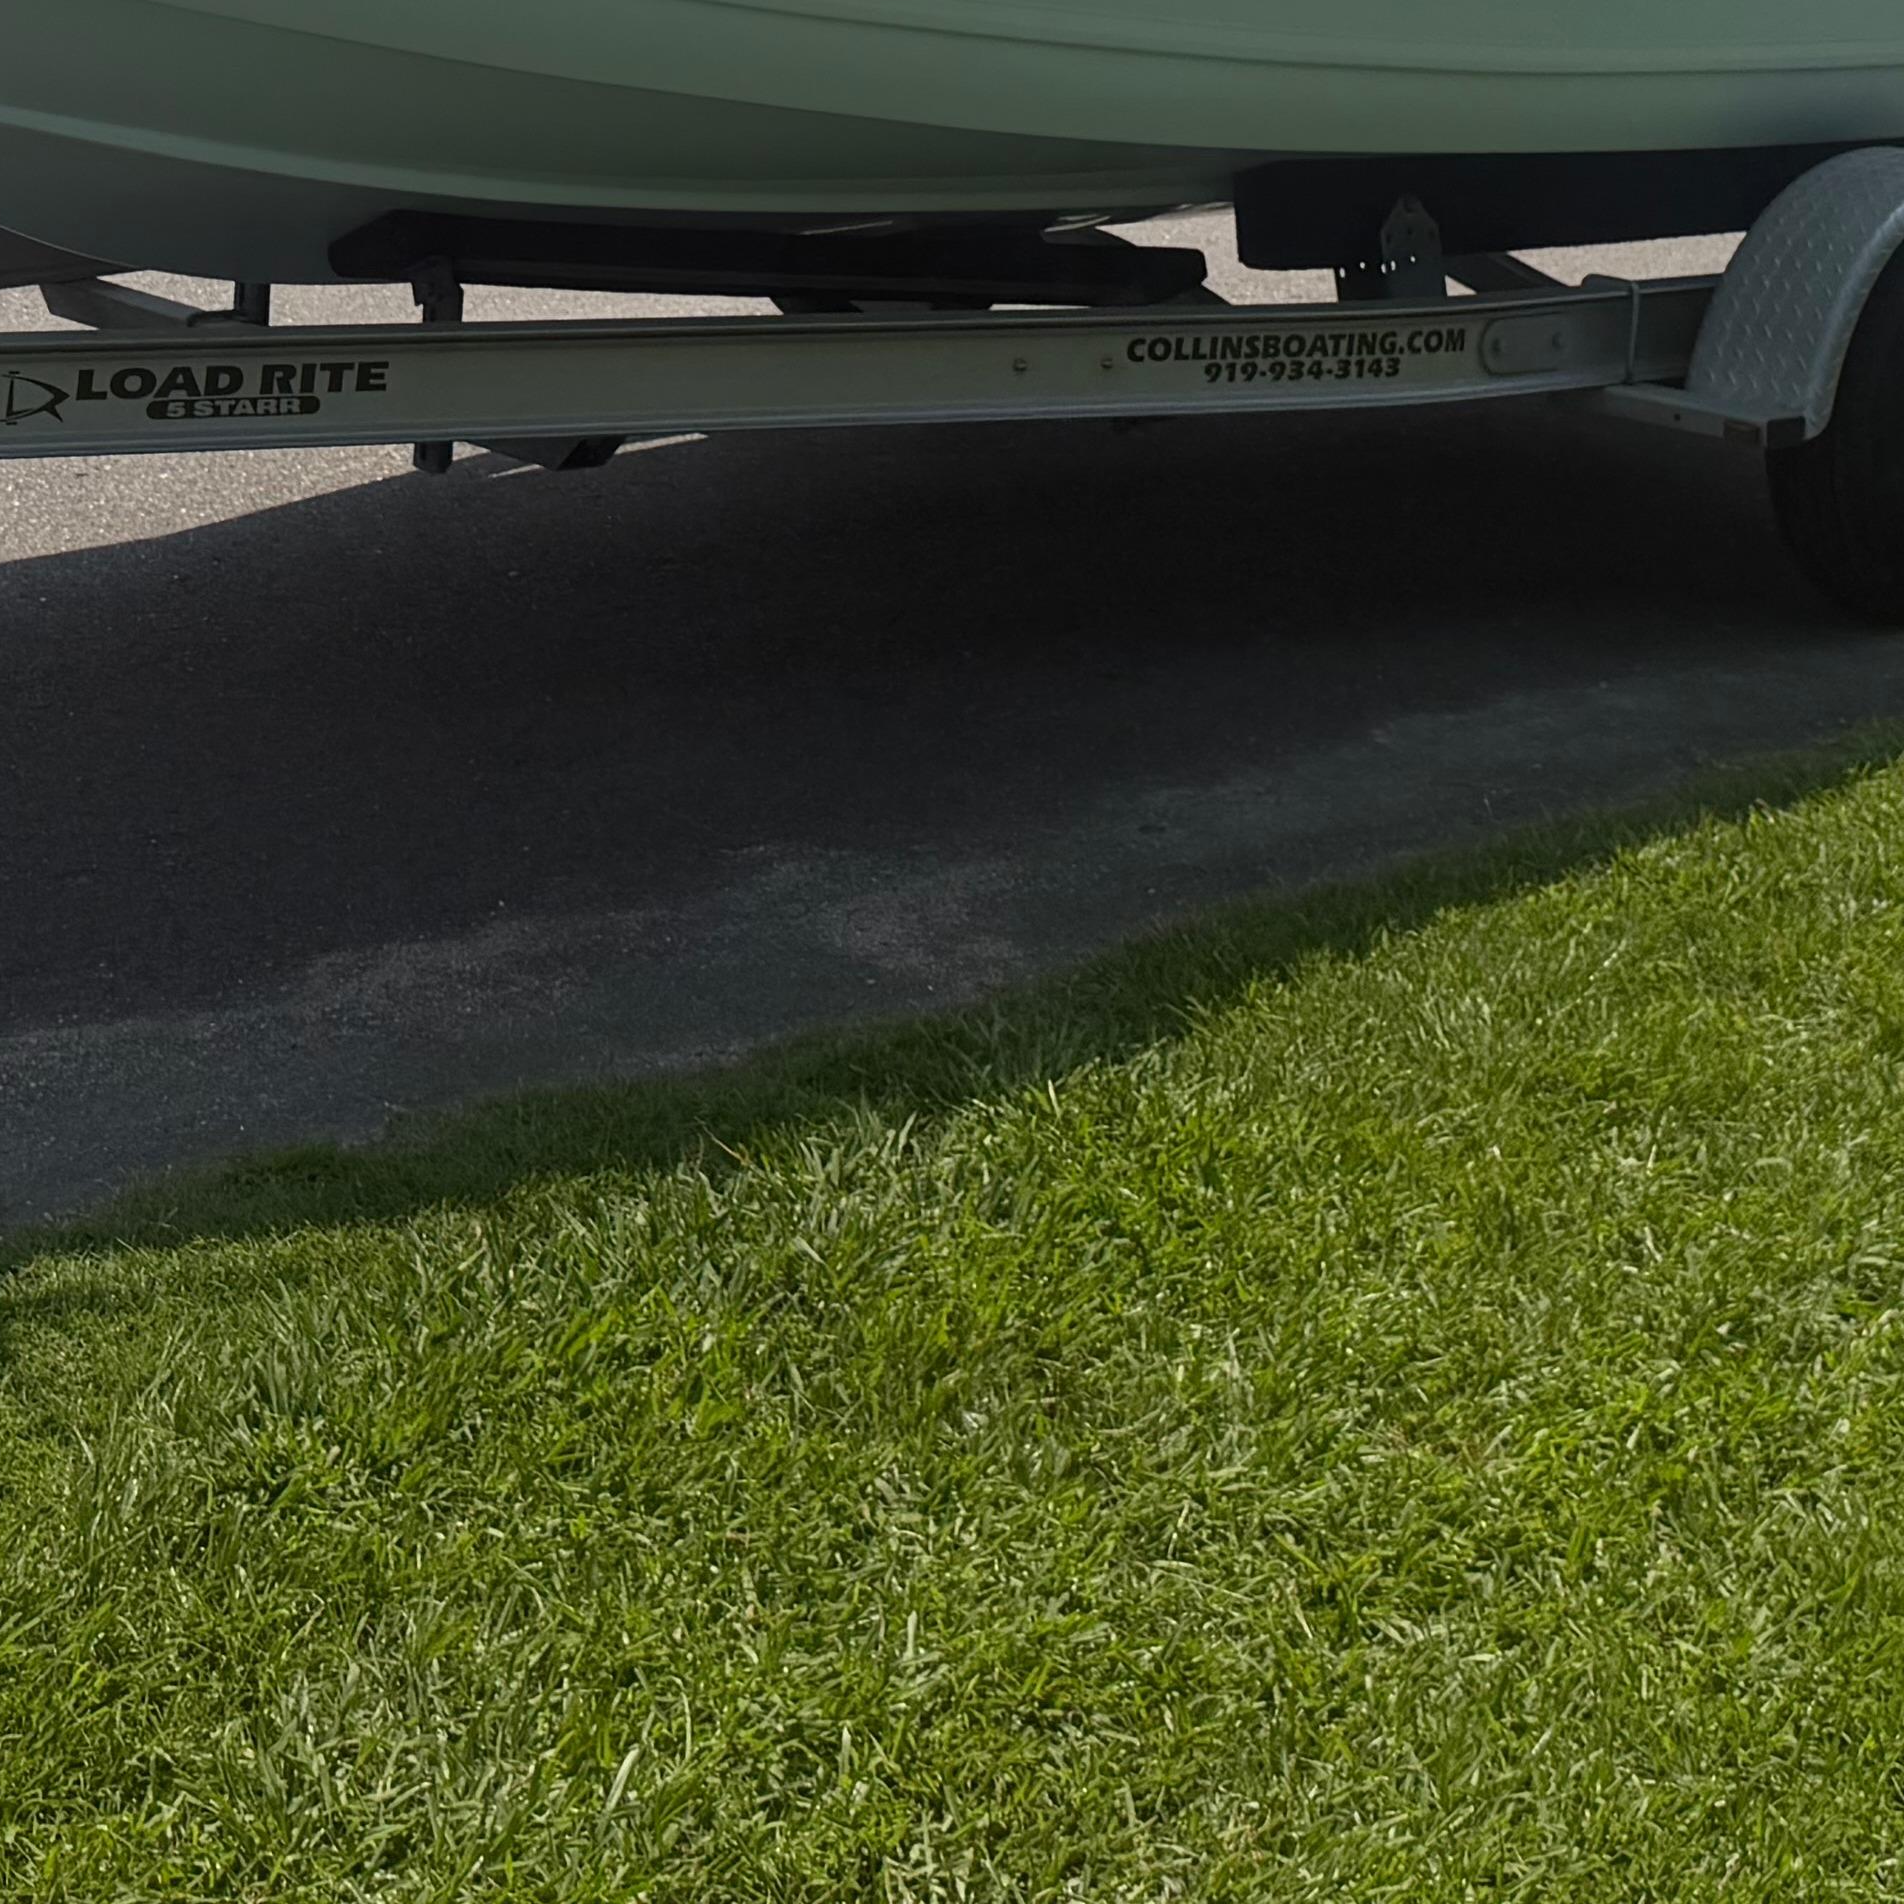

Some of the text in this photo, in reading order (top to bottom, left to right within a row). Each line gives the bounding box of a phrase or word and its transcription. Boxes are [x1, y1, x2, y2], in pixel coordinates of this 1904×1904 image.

[1126, 328, 1466, 363] COLLINSBOATING.COM
[75, 361, 390, 401] LOAD RITE
[1204, 357, 1401, 383] 919-934-3143
[166, 398, 302, 418] 5 STARR
